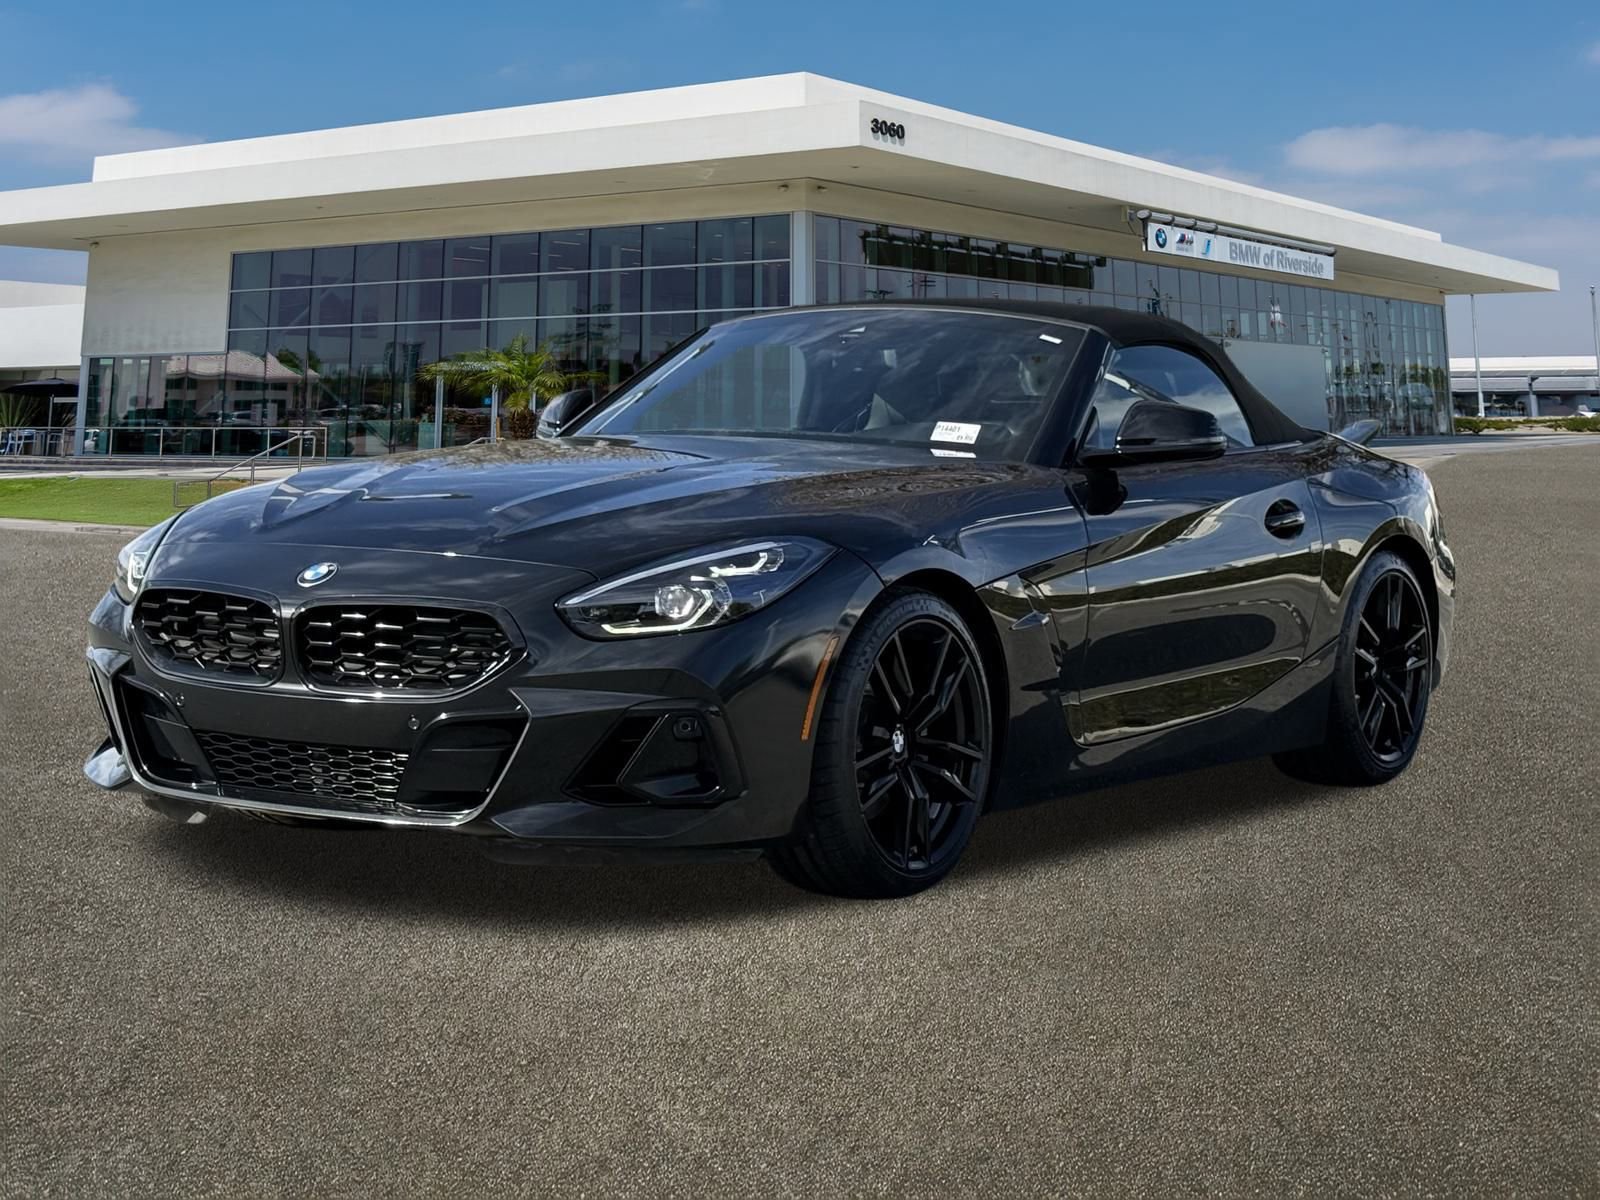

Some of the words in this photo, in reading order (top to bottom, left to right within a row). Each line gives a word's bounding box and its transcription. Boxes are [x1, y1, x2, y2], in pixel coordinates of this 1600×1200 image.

[871, 118, 905, 139] 3060
[1229, 242, 1261, 264] BMW
[1263, 249, 1275, 266] of
[1276, 251, 1324, 274] Riverside
